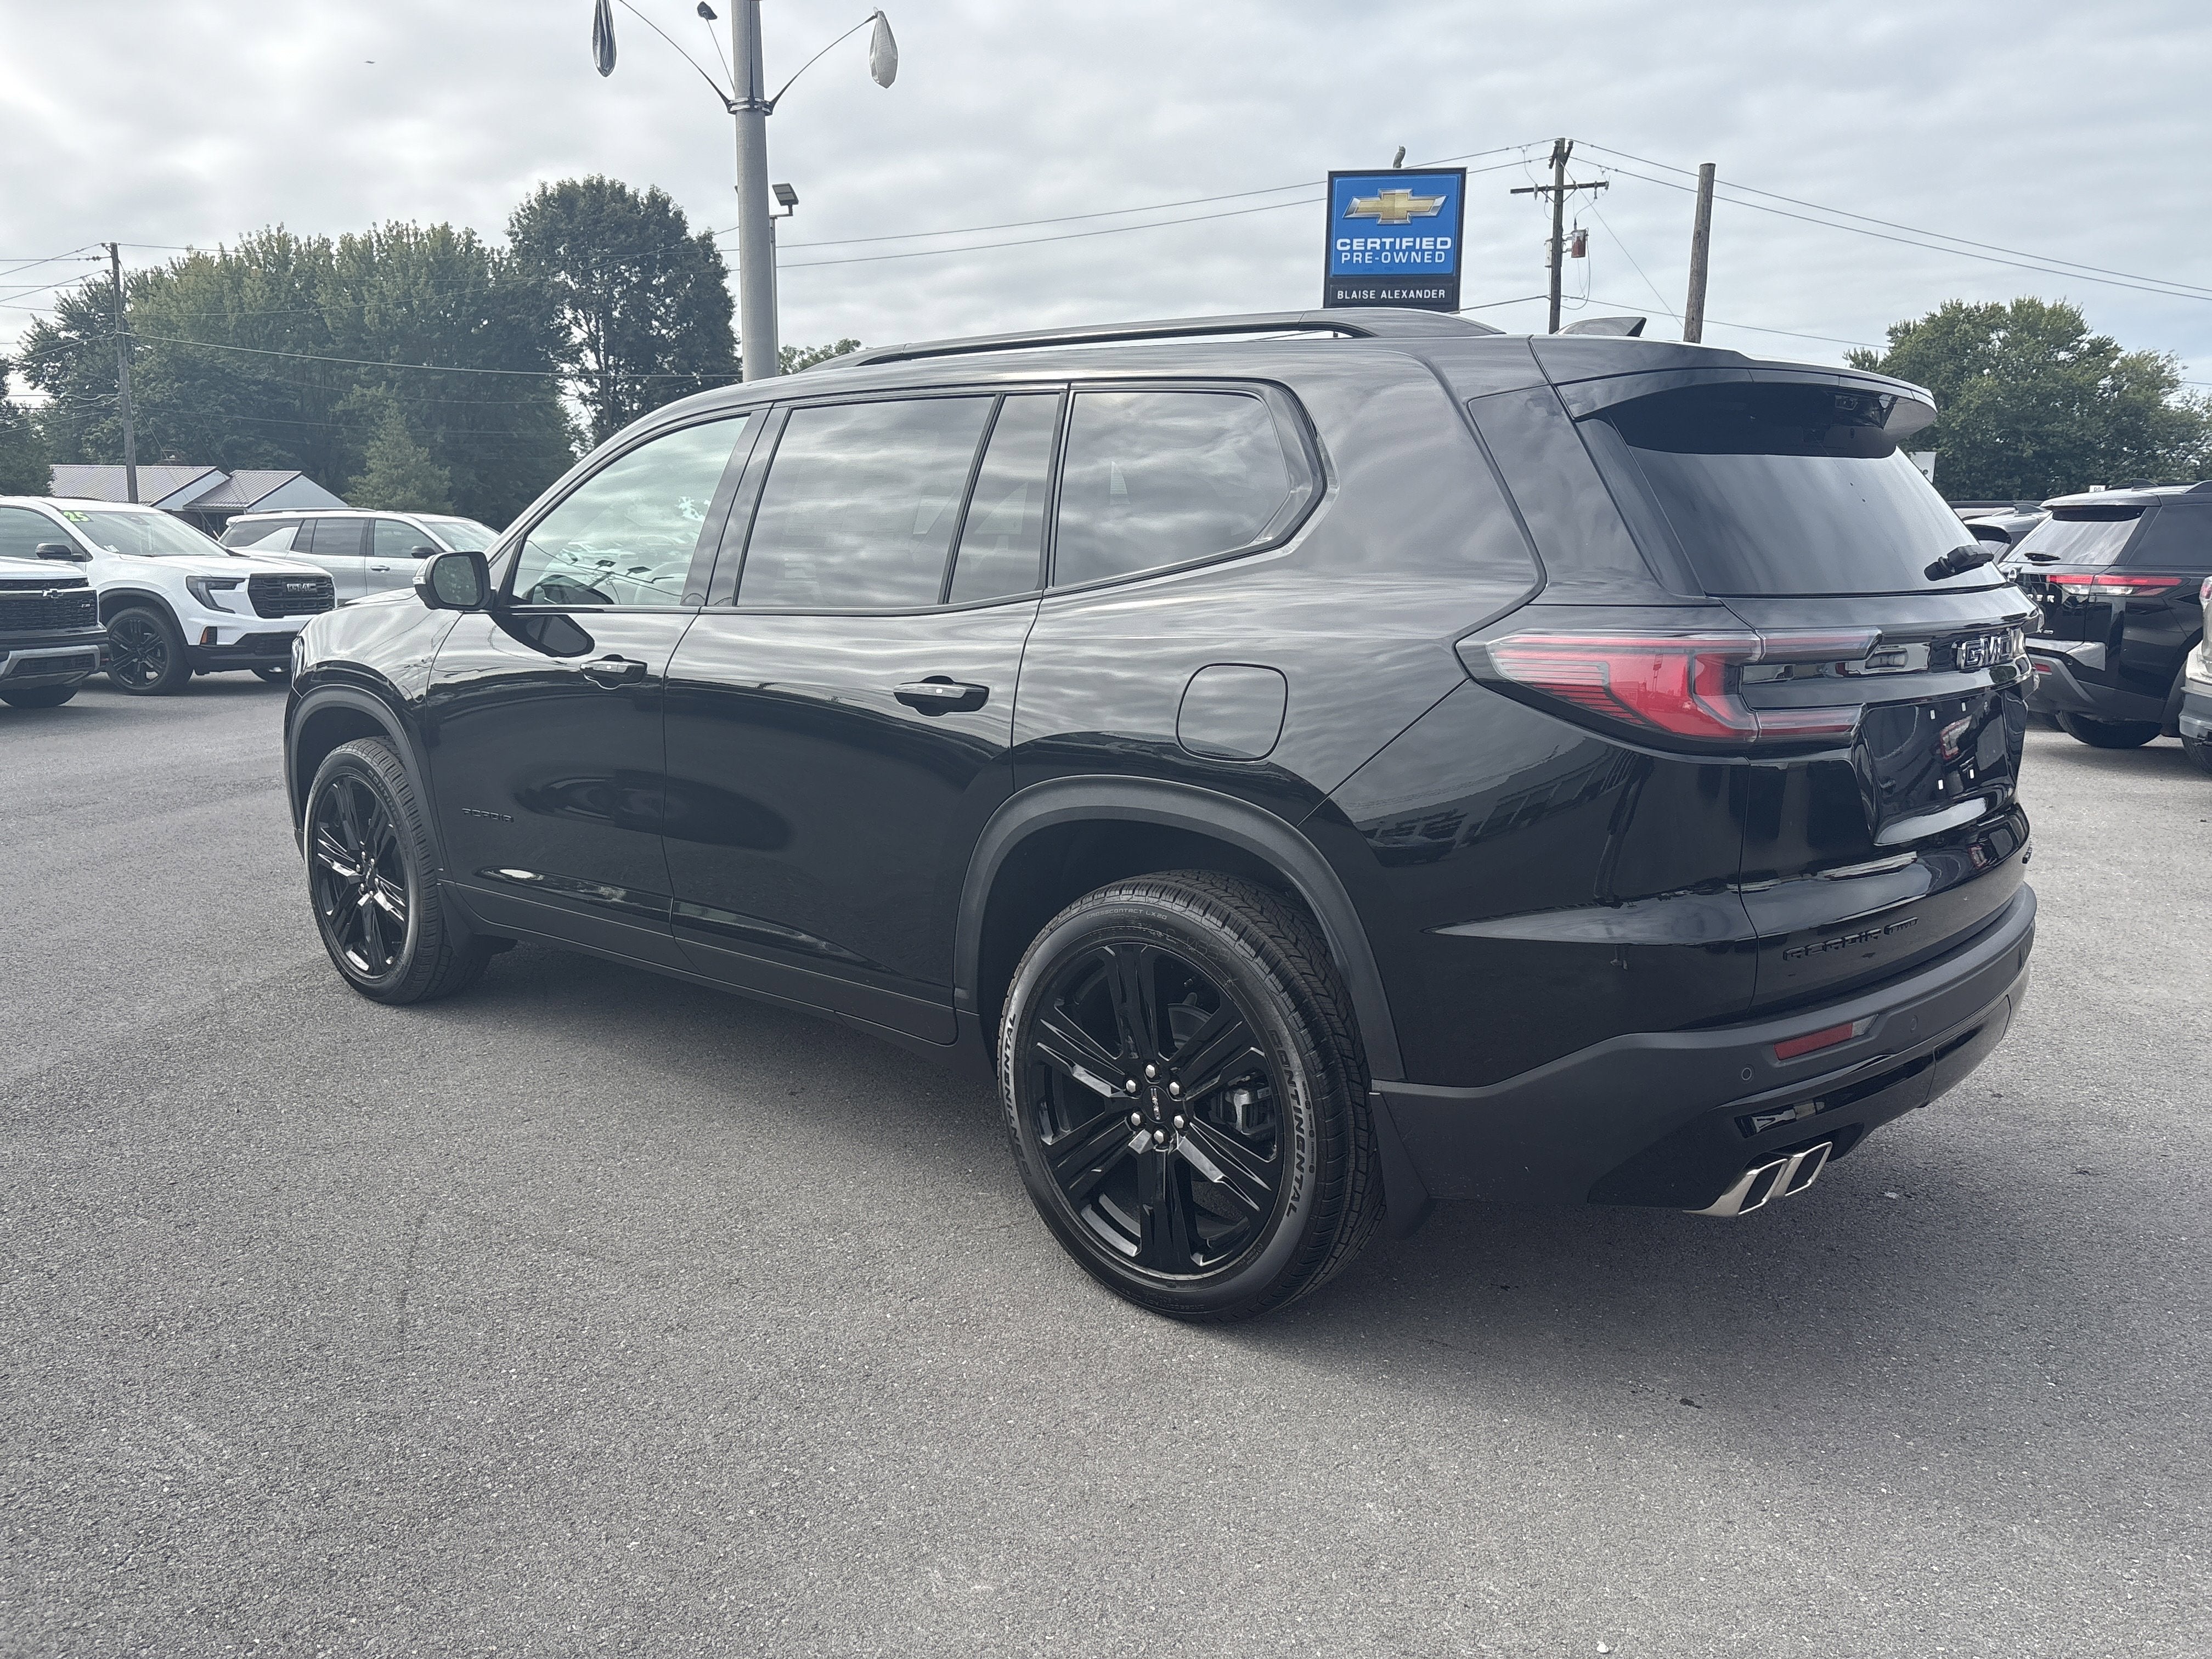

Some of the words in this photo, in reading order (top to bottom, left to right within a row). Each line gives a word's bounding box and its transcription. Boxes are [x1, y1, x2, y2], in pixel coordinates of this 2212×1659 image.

[1336, 237, 1452, 251] CERTIFIED
[1341, 251, 1445, 264] PRE-OWNED
[1337, 290, 1375, 300] BLAISE
[1380, 289, 1445, 300] ALEXANDER
[63, 511, 89, 522] 25
[286, 583, 317, 592] GMC
[1957, 628, 2016, 669] GMC
[1146, 910, 1167, 921] LX20
[1004, 1013, 1031, 1177] CONTINENTAL
[1268, 1029, 1306, 1218] CONTINENTAL
